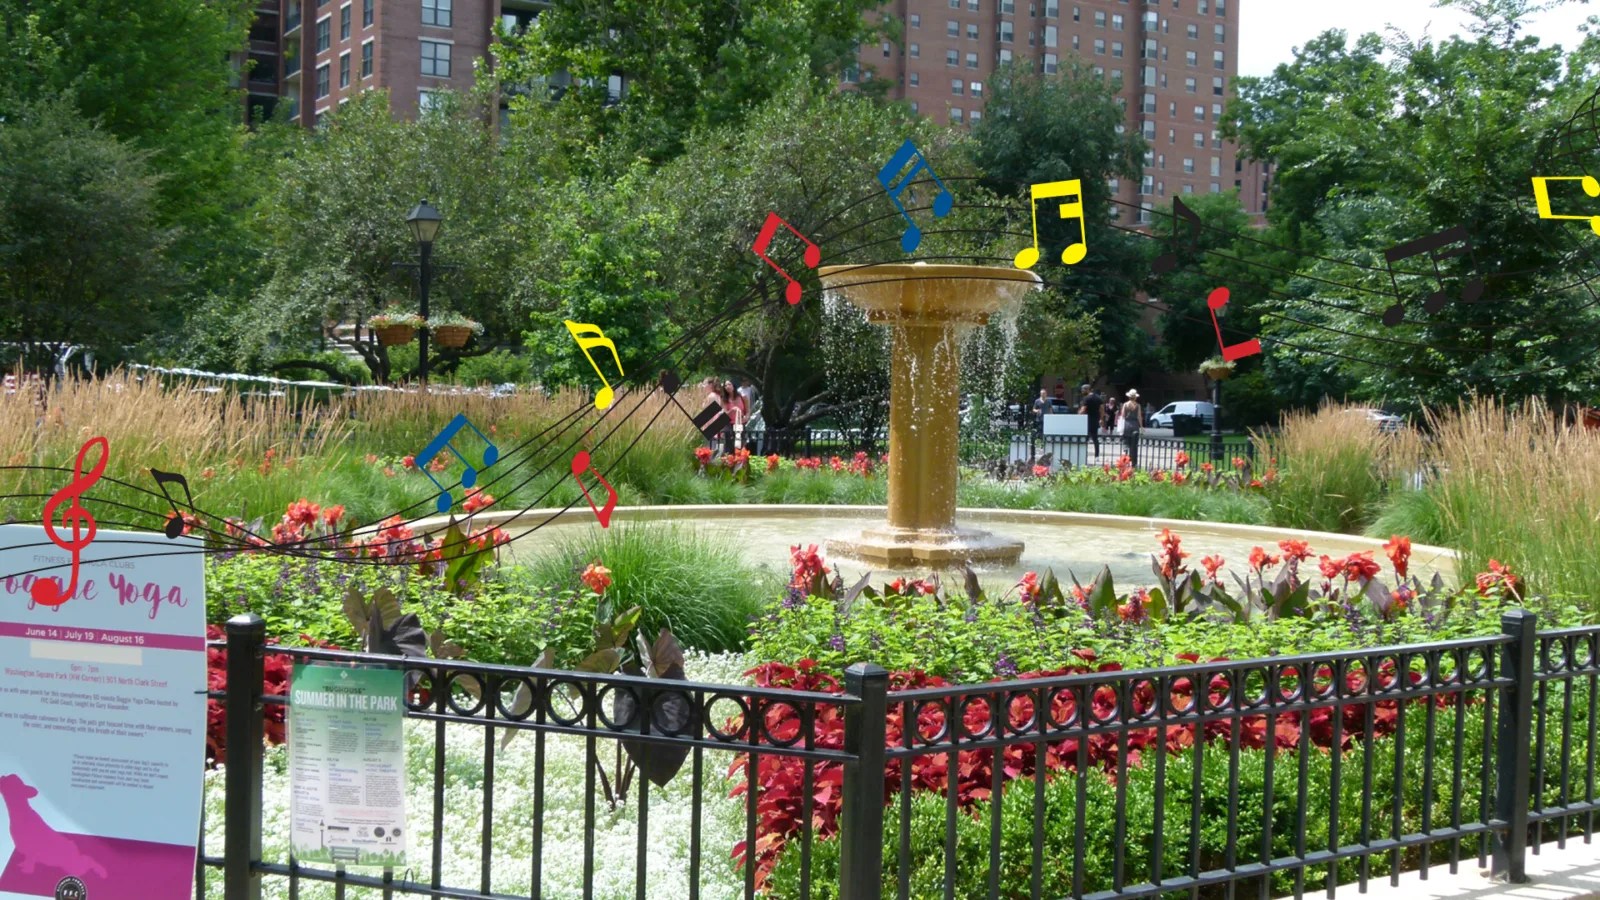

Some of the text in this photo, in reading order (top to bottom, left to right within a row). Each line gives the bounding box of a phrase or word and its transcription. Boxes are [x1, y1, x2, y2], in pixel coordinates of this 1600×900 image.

[33, 555, 65, 564] FITNESS
[108, 561, 135, 569] CLUBS
[109, 572, 188, 620] Yoga
[25, 628, 145, 645] June 14 July 19 August 16
[36, 670, 55, 679] Square
[55, 672, 67, 680] Park
[118, 677, 133, 685] North
[134, 678, 149, 687] Clark
[150, 679, 167, 688] Street
[294, 689, 335, 708] SUMMER
[336, 692, 347, 709] IN
[348, 693, 368, 710] THE
[370, 695, 398, 712] PARK
